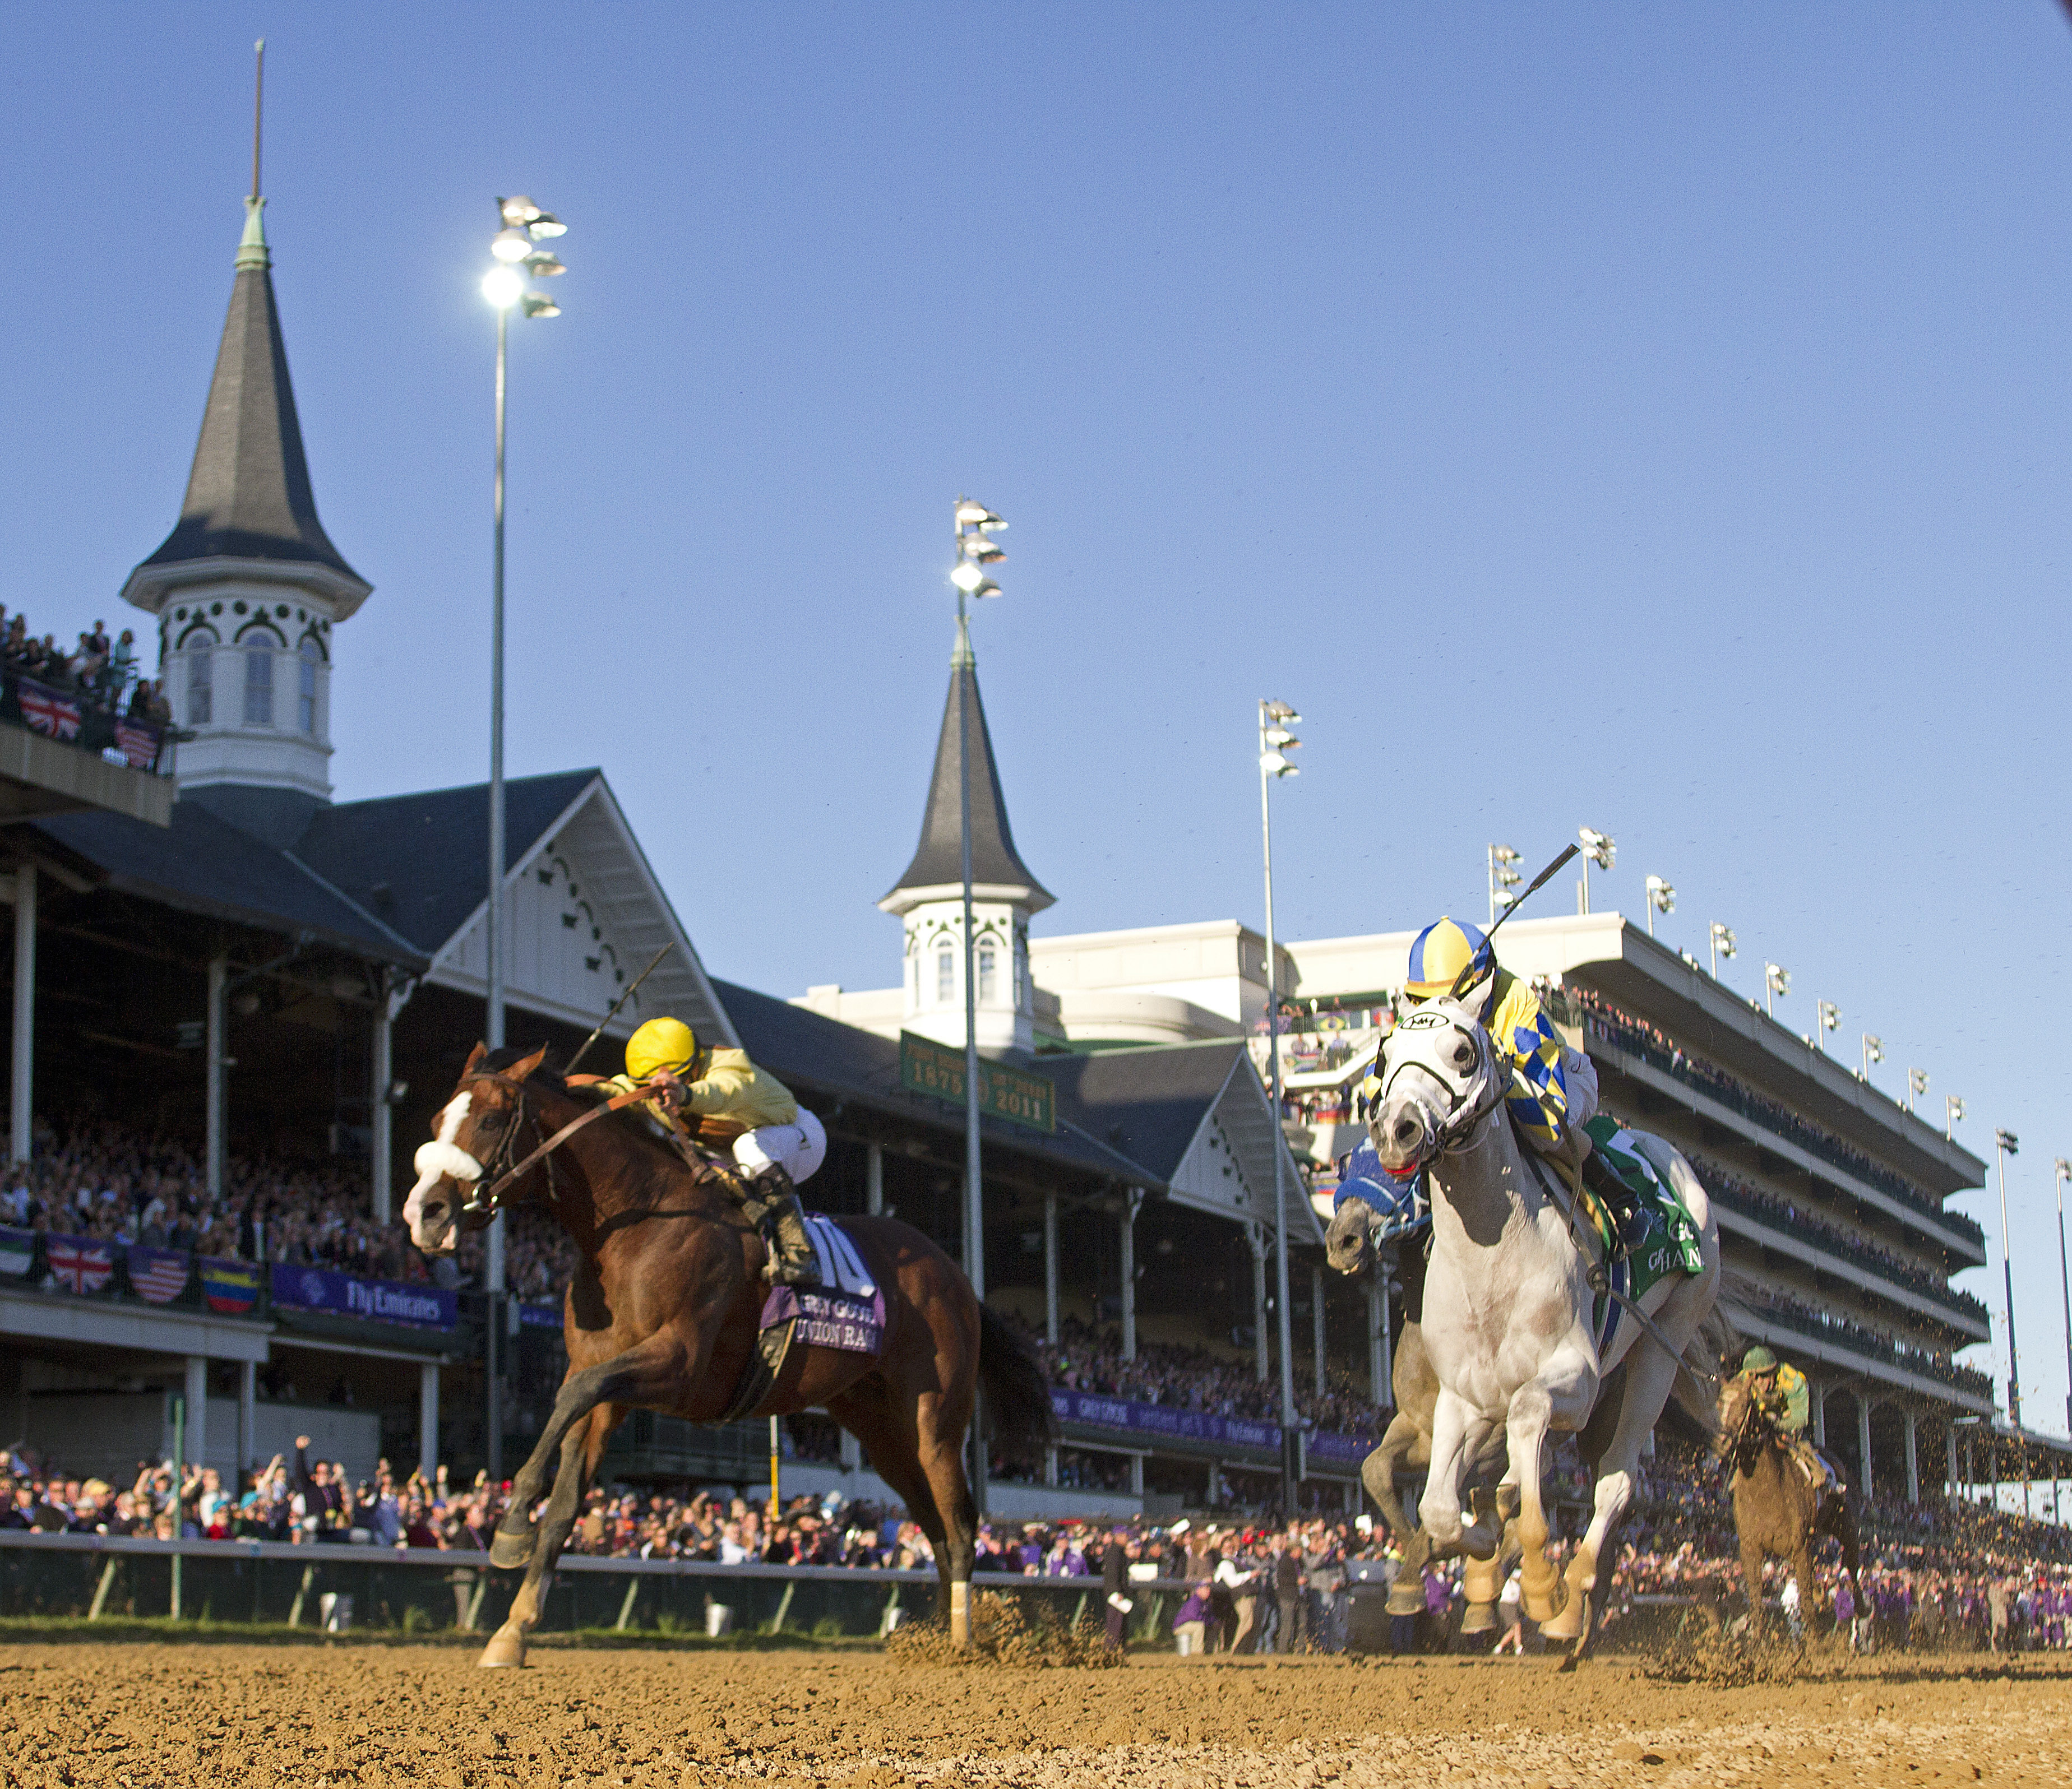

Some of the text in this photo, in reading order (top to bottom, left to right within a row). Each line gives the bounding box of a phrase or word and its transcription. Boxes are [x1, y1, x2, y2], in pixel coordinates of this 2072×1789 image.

[996, 1090, 1042, 1120] 2011
[1660, 1246, 1705, 1274] HAN
[796, 1318, 841, 1348] UNION
